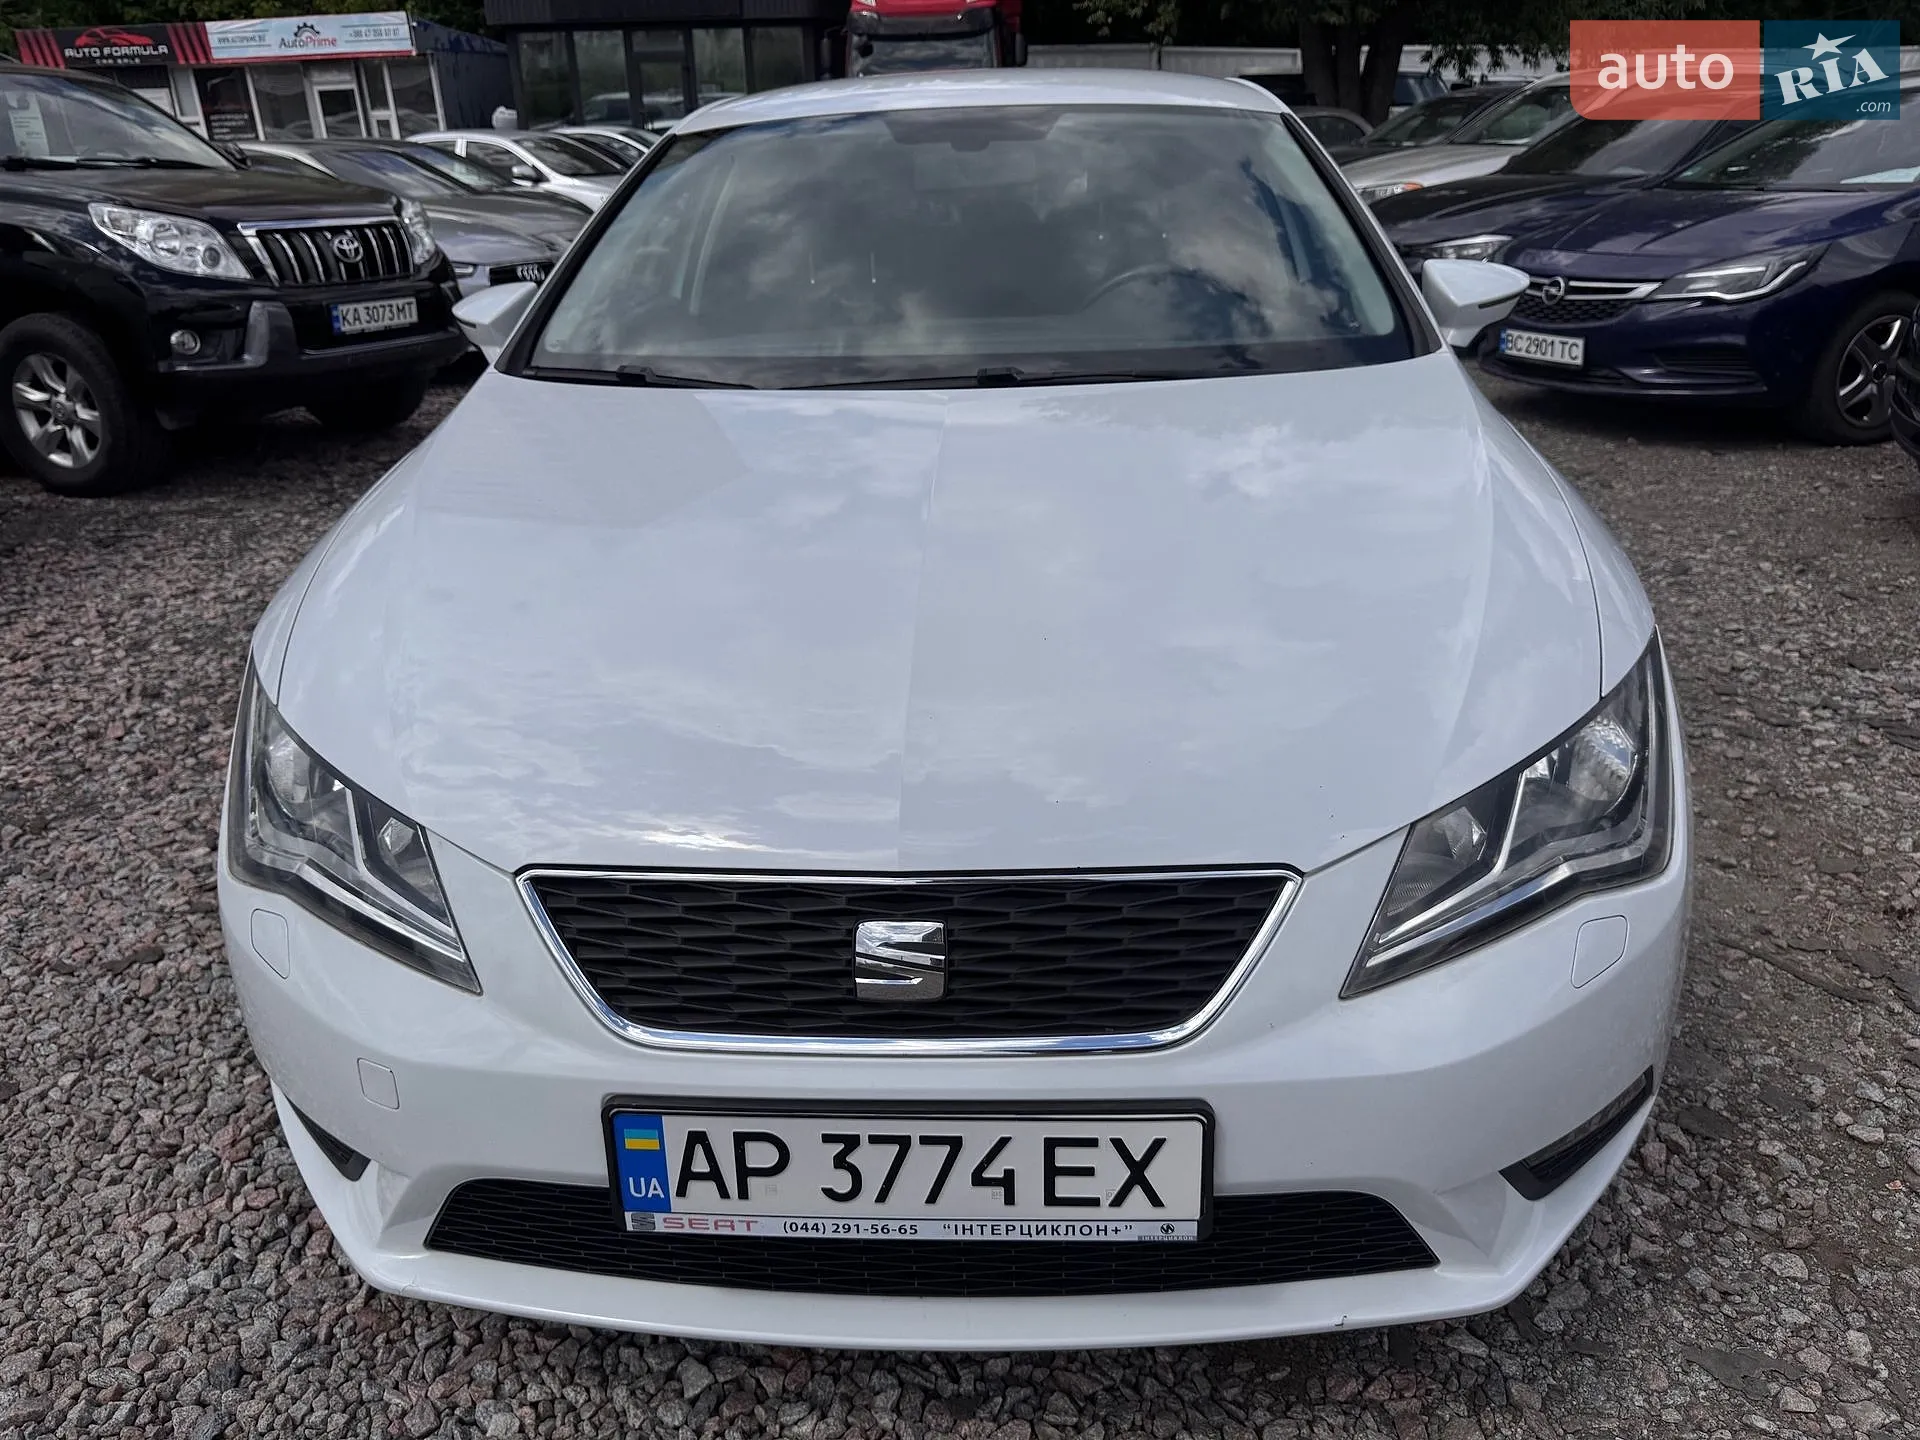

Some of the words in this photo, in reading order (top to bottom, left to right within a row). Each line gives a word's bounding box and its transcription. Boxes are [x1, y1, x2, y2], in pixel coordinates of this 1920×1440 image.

[64, 47, 100, 58] AUTO
[103, 45, 168, 57] FORMULA
[279, 36, 337, 49] AutoPrime
[341, 307, 363, 327] KA
[363, 304, 395, 324] 3073
[396, 301, 413, 321] MT
[1505, 333, 1523, 352] BC
[1525, 336, 1554, 358] 2901
[1559, 340, 1579, 360] TC
[675, 1130, 791, 1199] AP
[820, 1133, 1016, 1206] 3774
[1043, 1137, 1167, 1208] EX
[629, 1177, 664, 1198] UA
[662, 1217, 759, 1232] SEAT
[783, 1220, 826, 1235] (044)
[831, 1222, 918, 1235] 291-56-65
